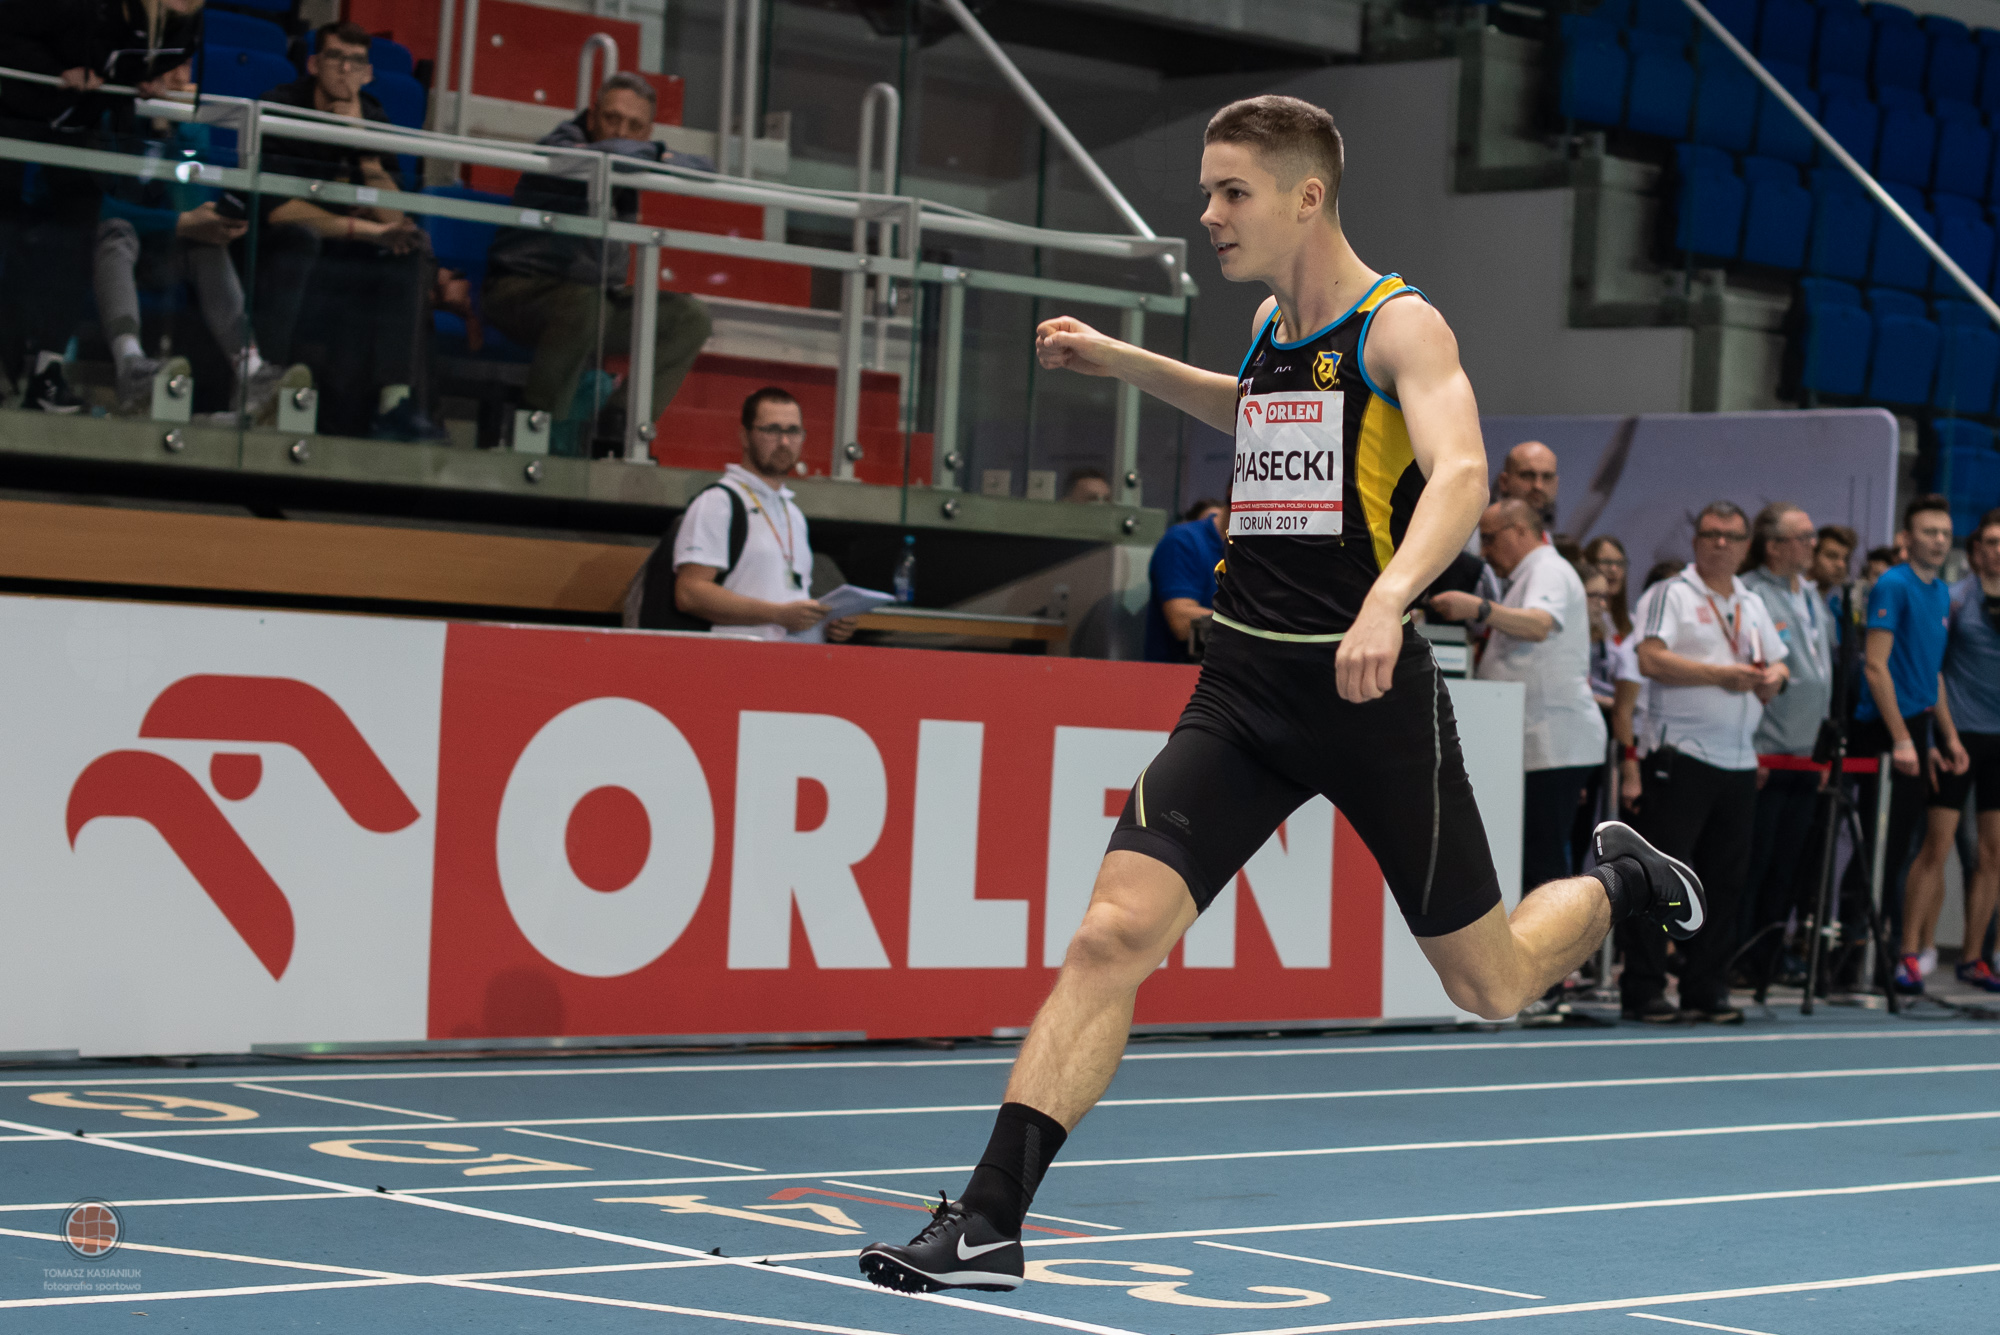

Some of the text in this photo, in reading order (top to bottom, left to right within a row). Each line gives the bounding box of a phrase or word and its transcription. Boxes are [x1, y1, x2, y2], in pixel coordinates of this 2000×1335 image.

[1267, 403, 1319, 421] ORLEN
[1235, 450, 1334, 483] PIASECKI
[1240, 512, 1308, 530] TORUŃ 2019
